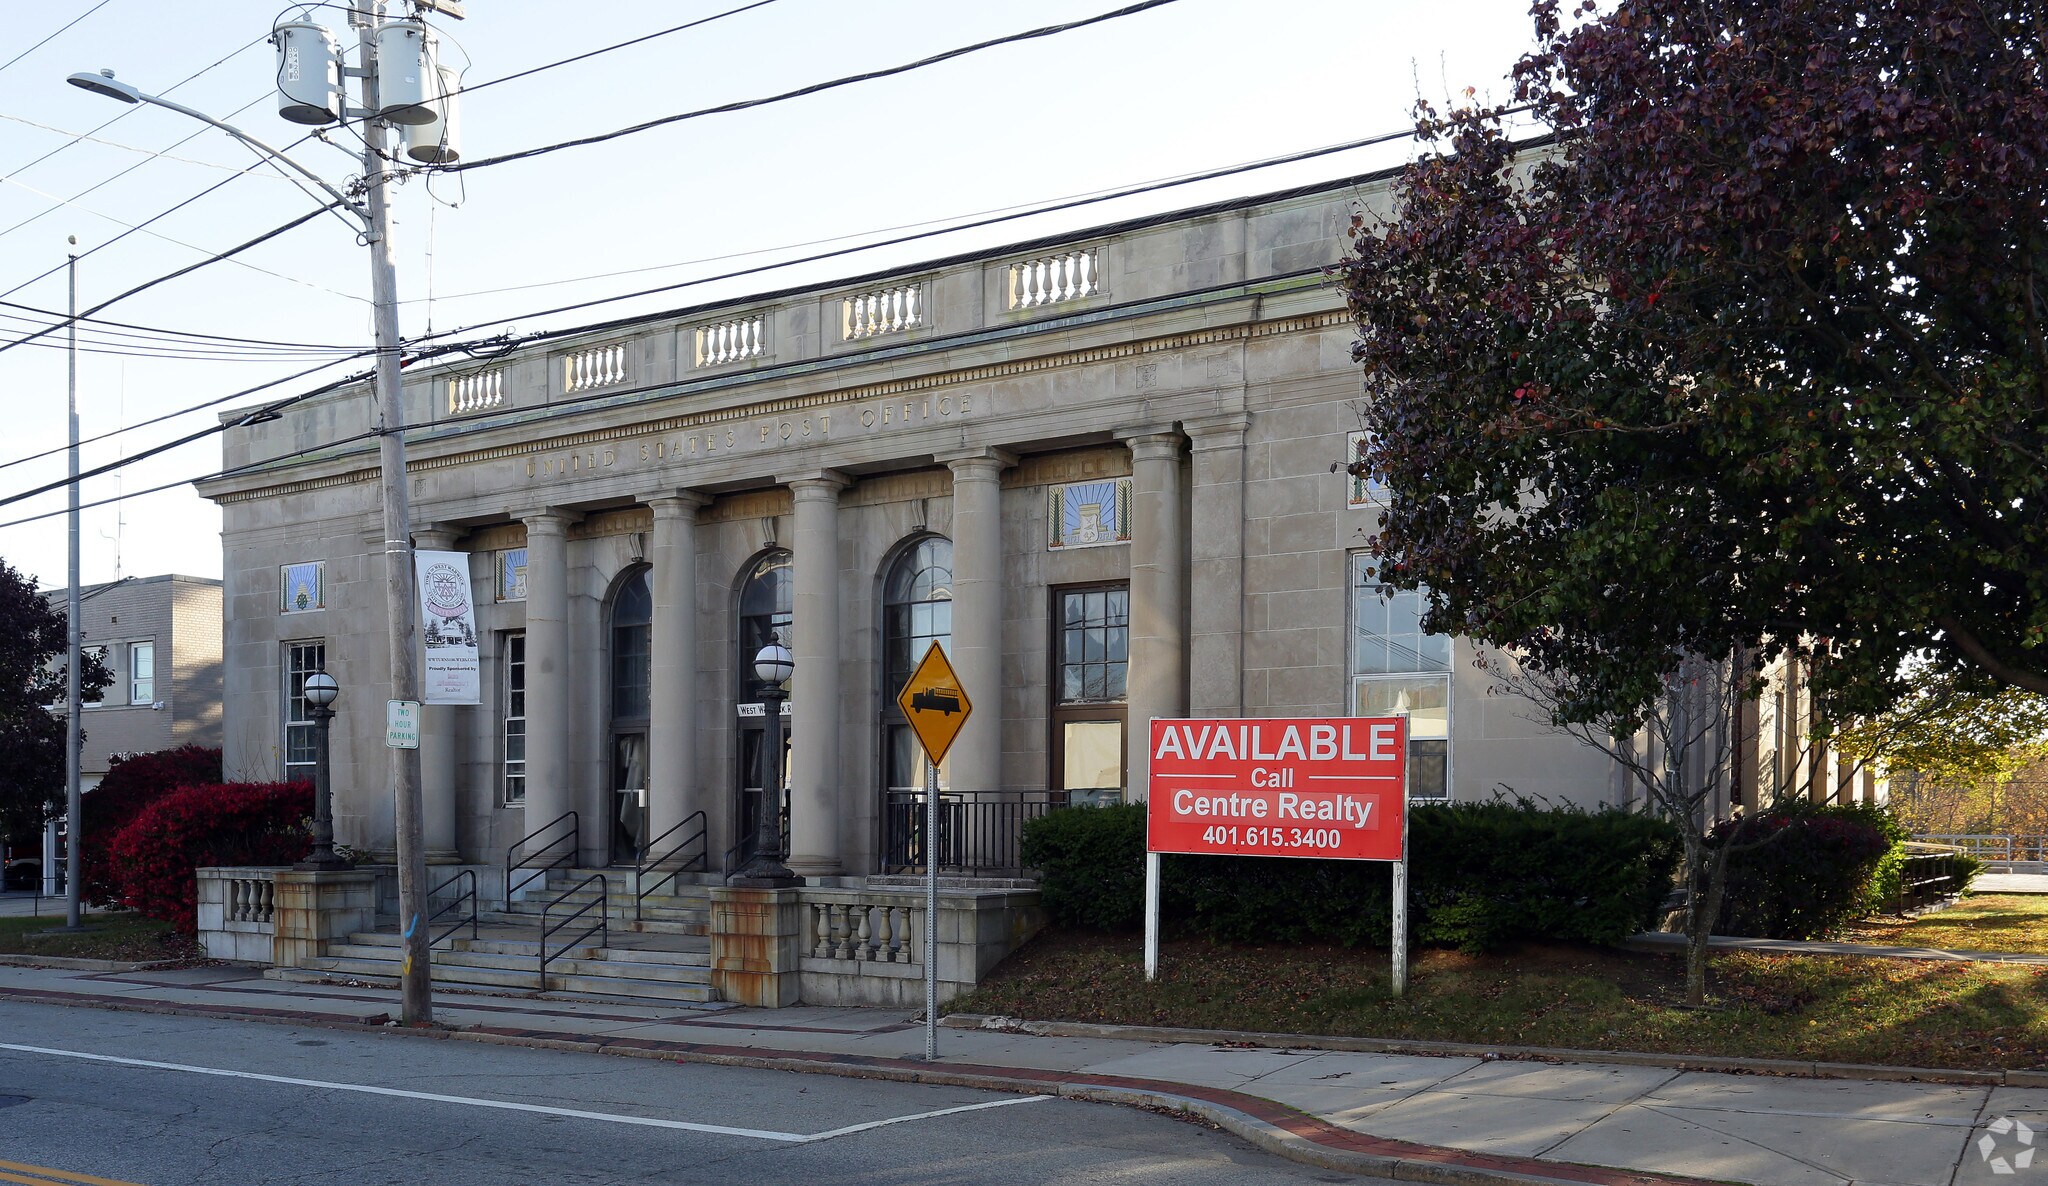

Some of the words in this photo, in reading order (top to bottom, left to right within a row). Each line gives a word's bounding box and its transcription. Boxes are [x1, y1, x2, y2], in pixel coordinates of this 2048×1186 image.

[525, 449, 616, 478] UNITED
[640, 430, 736, 462] STATES
[760, 416, 831, 443] POST
[861, 393, 972, 428] OFFICE
[397, 708, 410, 717] TWO
[740, 705, 757, 715] WEST
[394, 720, 412, 729] HOUR
[389, 731, 416, 741] PARKING
[1155, 724, 1396, 761] AVAILABLE
[109, 752, 127, 762] FRE
[1250, 767, 1294, 788] Call
[1173, 789, 1268, 818] Centre
[1278, 793, 1373, 829] Realty
[1202, 825, 1341, 849] 401.615.3400
